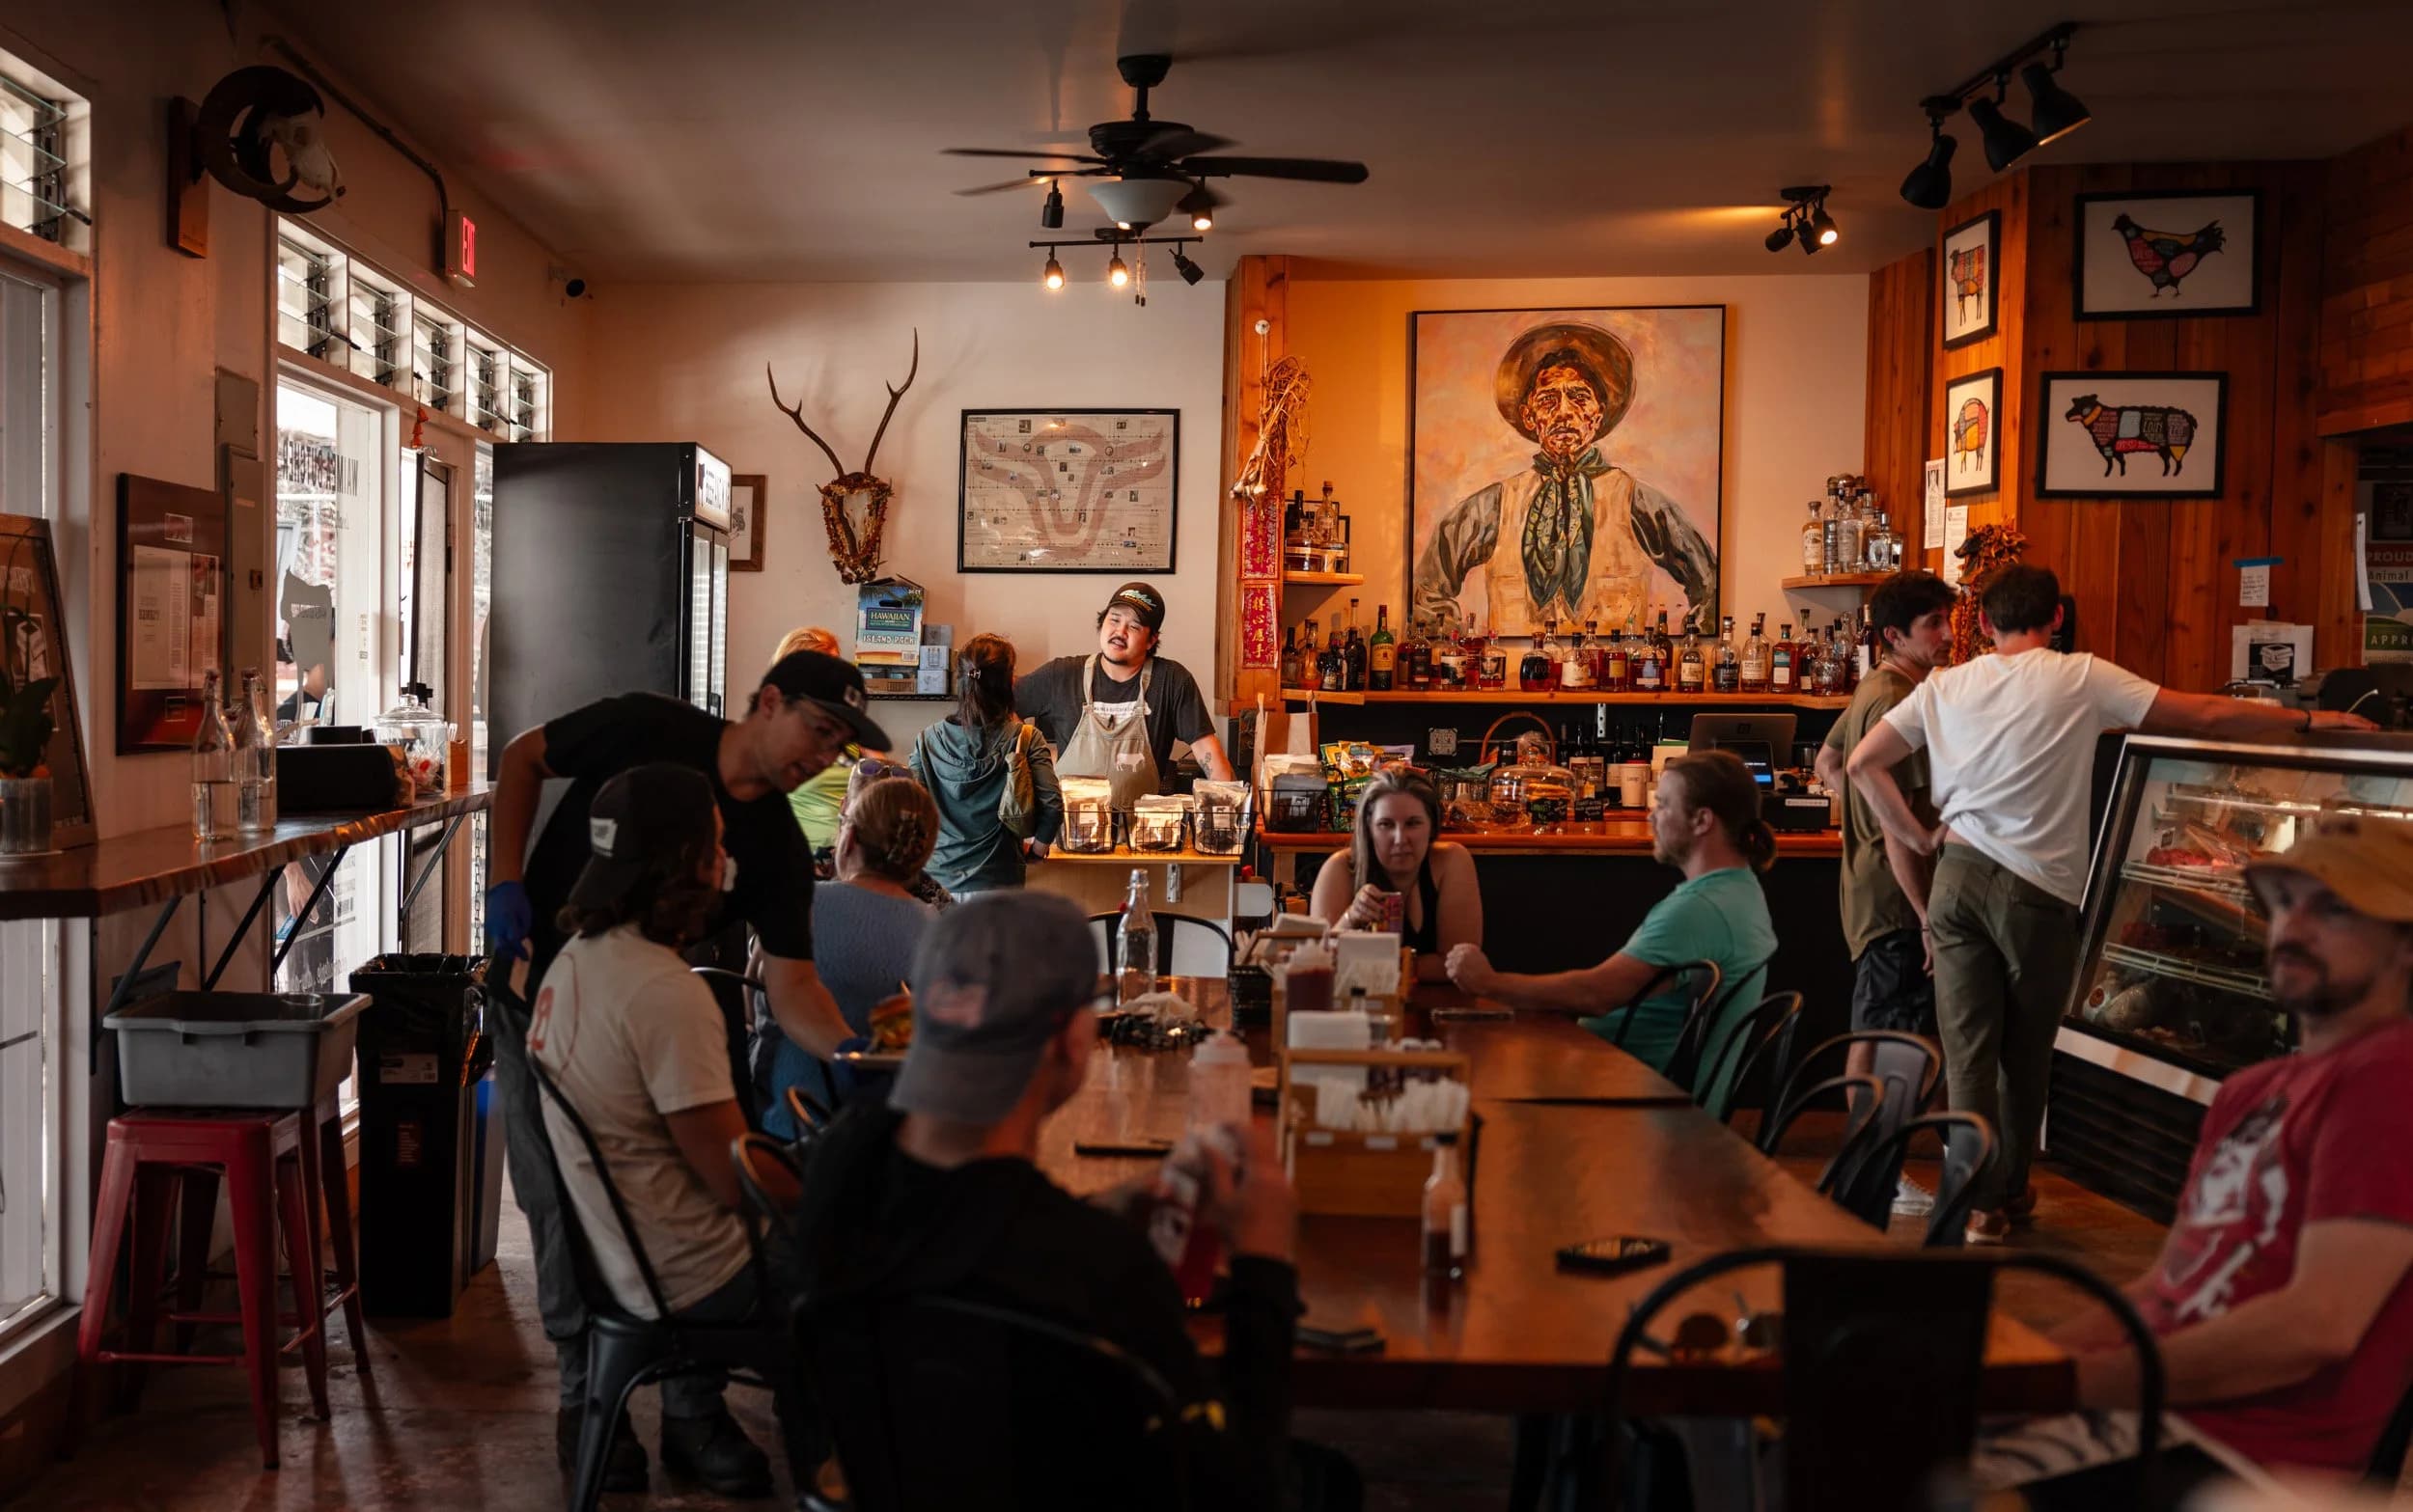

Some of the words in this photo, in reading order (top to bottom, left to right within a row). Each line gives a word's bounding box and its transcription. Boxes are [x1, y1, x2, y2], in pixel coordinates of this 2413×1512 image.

[2368, 569, 2409, 581] Animal
[871, 611, 910, 620] HAWAIIAN
[863, 634, 892, 644] ISLAND
[894, 636, 915, 645] PACK
[2371, 634, 2413, 646] APPR
